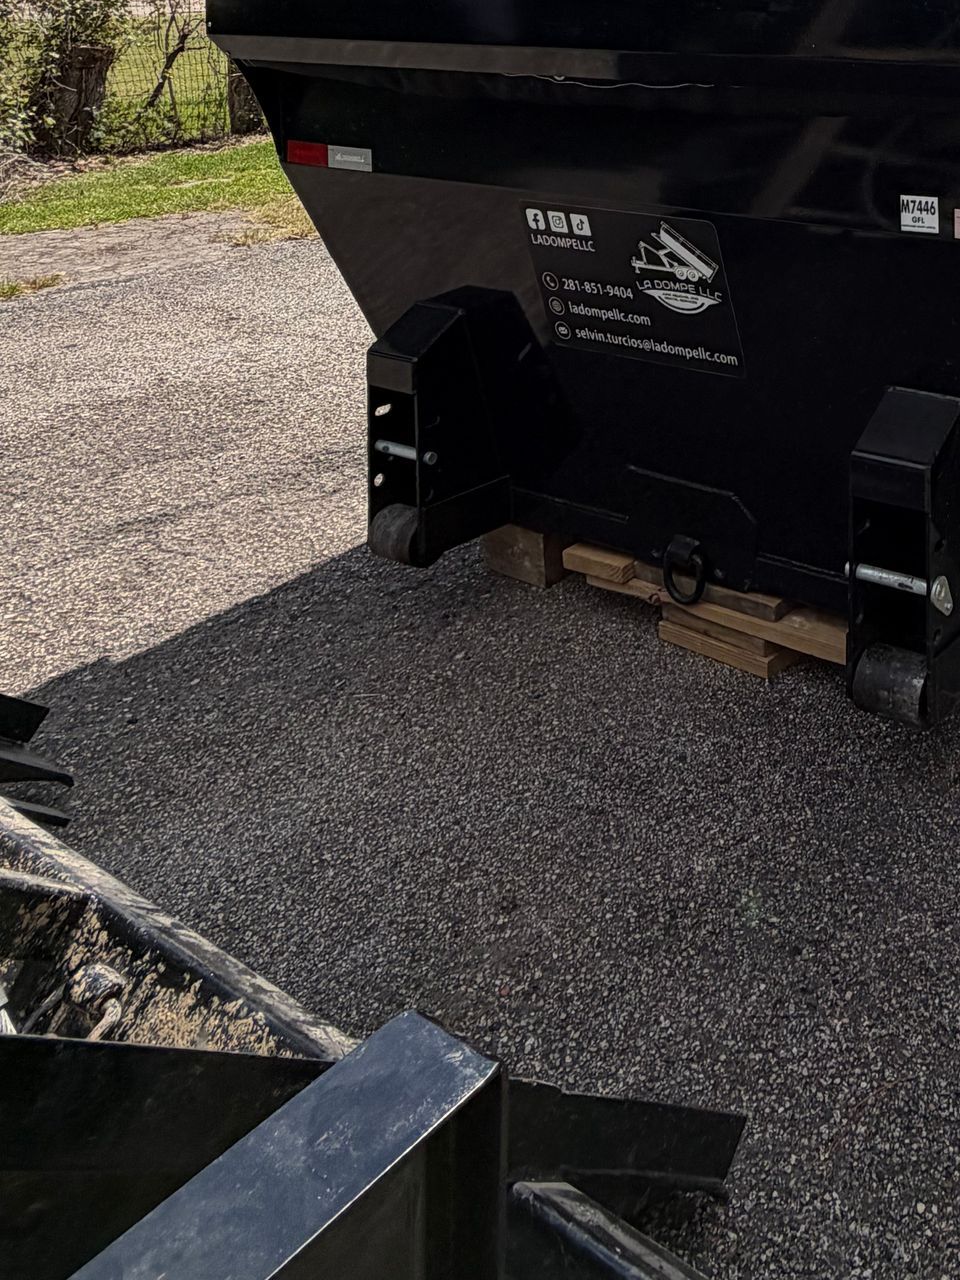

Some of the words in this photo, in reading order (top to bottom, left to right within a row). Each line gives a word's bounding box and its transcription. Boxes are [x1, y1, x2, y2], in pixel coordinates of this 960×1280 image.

[901, 199, 936, 216] M7446
[530, 233, 597, 252] LADOMPELLC
[561, 278, 634, 300] 281-851-9404
[636, 279, 652, 290] LA
[653, 279, 697, 294] DOMPE
[699, 286, 722, 302] LLC
[568, 301, 651, 326] ladompellc.com
[575, 327, 739, 366] selvin.turcios@ladompellc.com
